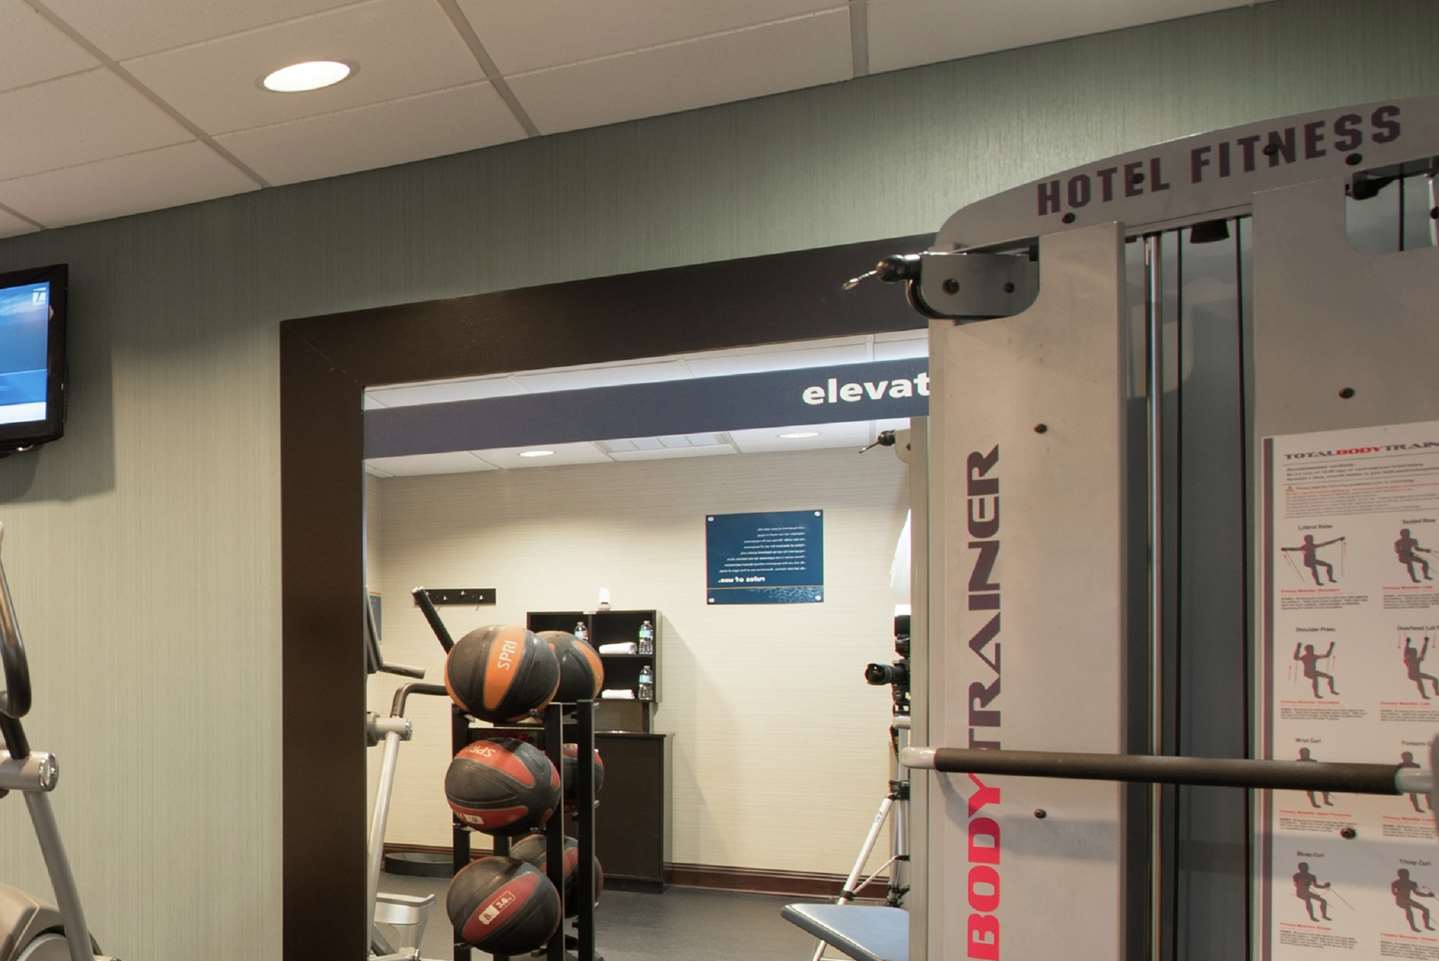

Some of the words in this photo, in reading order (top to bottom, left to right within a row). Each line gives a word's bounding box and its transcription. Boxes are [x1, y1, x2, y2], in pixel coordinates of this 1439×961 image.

[1037, 157, 1170, 217] HOTEL
[1190, 104, 1402, 184] FITNESS
[497, 641, 517, 670] SPRI
